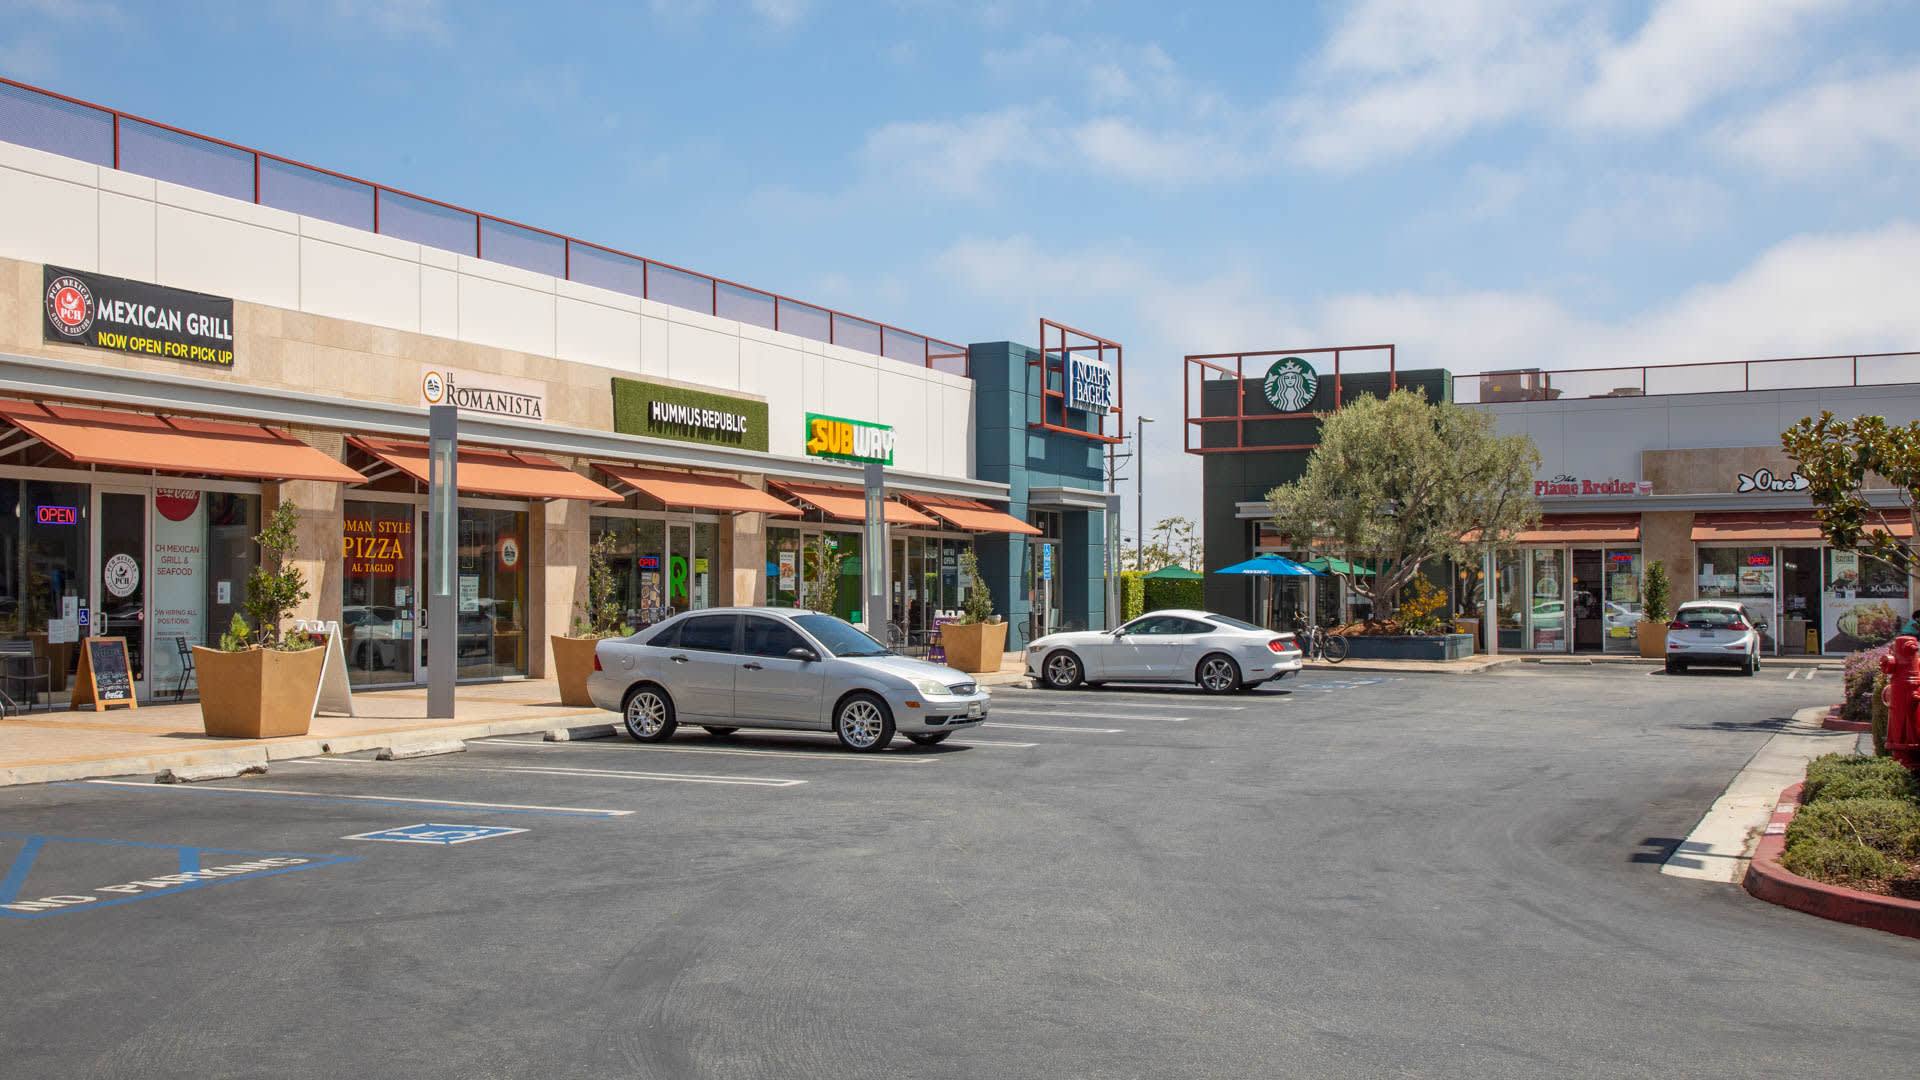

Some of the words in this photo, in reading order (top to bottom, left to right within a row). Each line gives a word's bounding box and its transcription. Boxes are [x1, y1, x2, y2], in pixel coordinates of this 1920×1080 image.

[49, 281, 62, 299] PCH
[62, 279, 92, 305] MEXICAN
[60, 307, 82, 320] PCH
[97, 296, 181, 333] MEXICAN
[186, 312, 233, 340] GRILL
[98, 331, 127, 349] NOW
[129, 336, 162, 354] OPEN
[164, 341, 188, 358] FOR
[190, 345, 216, 362] PICK
[218, 350, 233, 364] UP
[446, 372, 455, 384] IL
[1076, 360, 1112, 387] NOAH'S
[446, 384, 542, 417] ROMANISTA
[1076, 381, 1112, 408] BAGELS
[652, 400, 701, 427] HUMMUS
[701, 409, 747, 433] REPUBLIC
[808, 418, 896, 461] SUBWAY
[1534, 480, 1579, 496] Flame
[1581, 478, 1636, 496] Broiler
[1550, 474, 1577, 483] The
[1753, 468, 1795, 492] One
[39, 508, 75, 522] OPEN
[378, 521, 411, 533] STYLE
[167, 544, 200, 553] MEXICAN
[343, 536, 404, 559] PIZZA
[157, 567, 193, 576] SEAFOOD
[351, 563, 363, 572] AL
[365, 563, 394, 573] TAGLIO
[639, 558, 657, 567] OPEN
[0, 895, 98, 911] NO
[92, 857, 311, 893] PARKING
